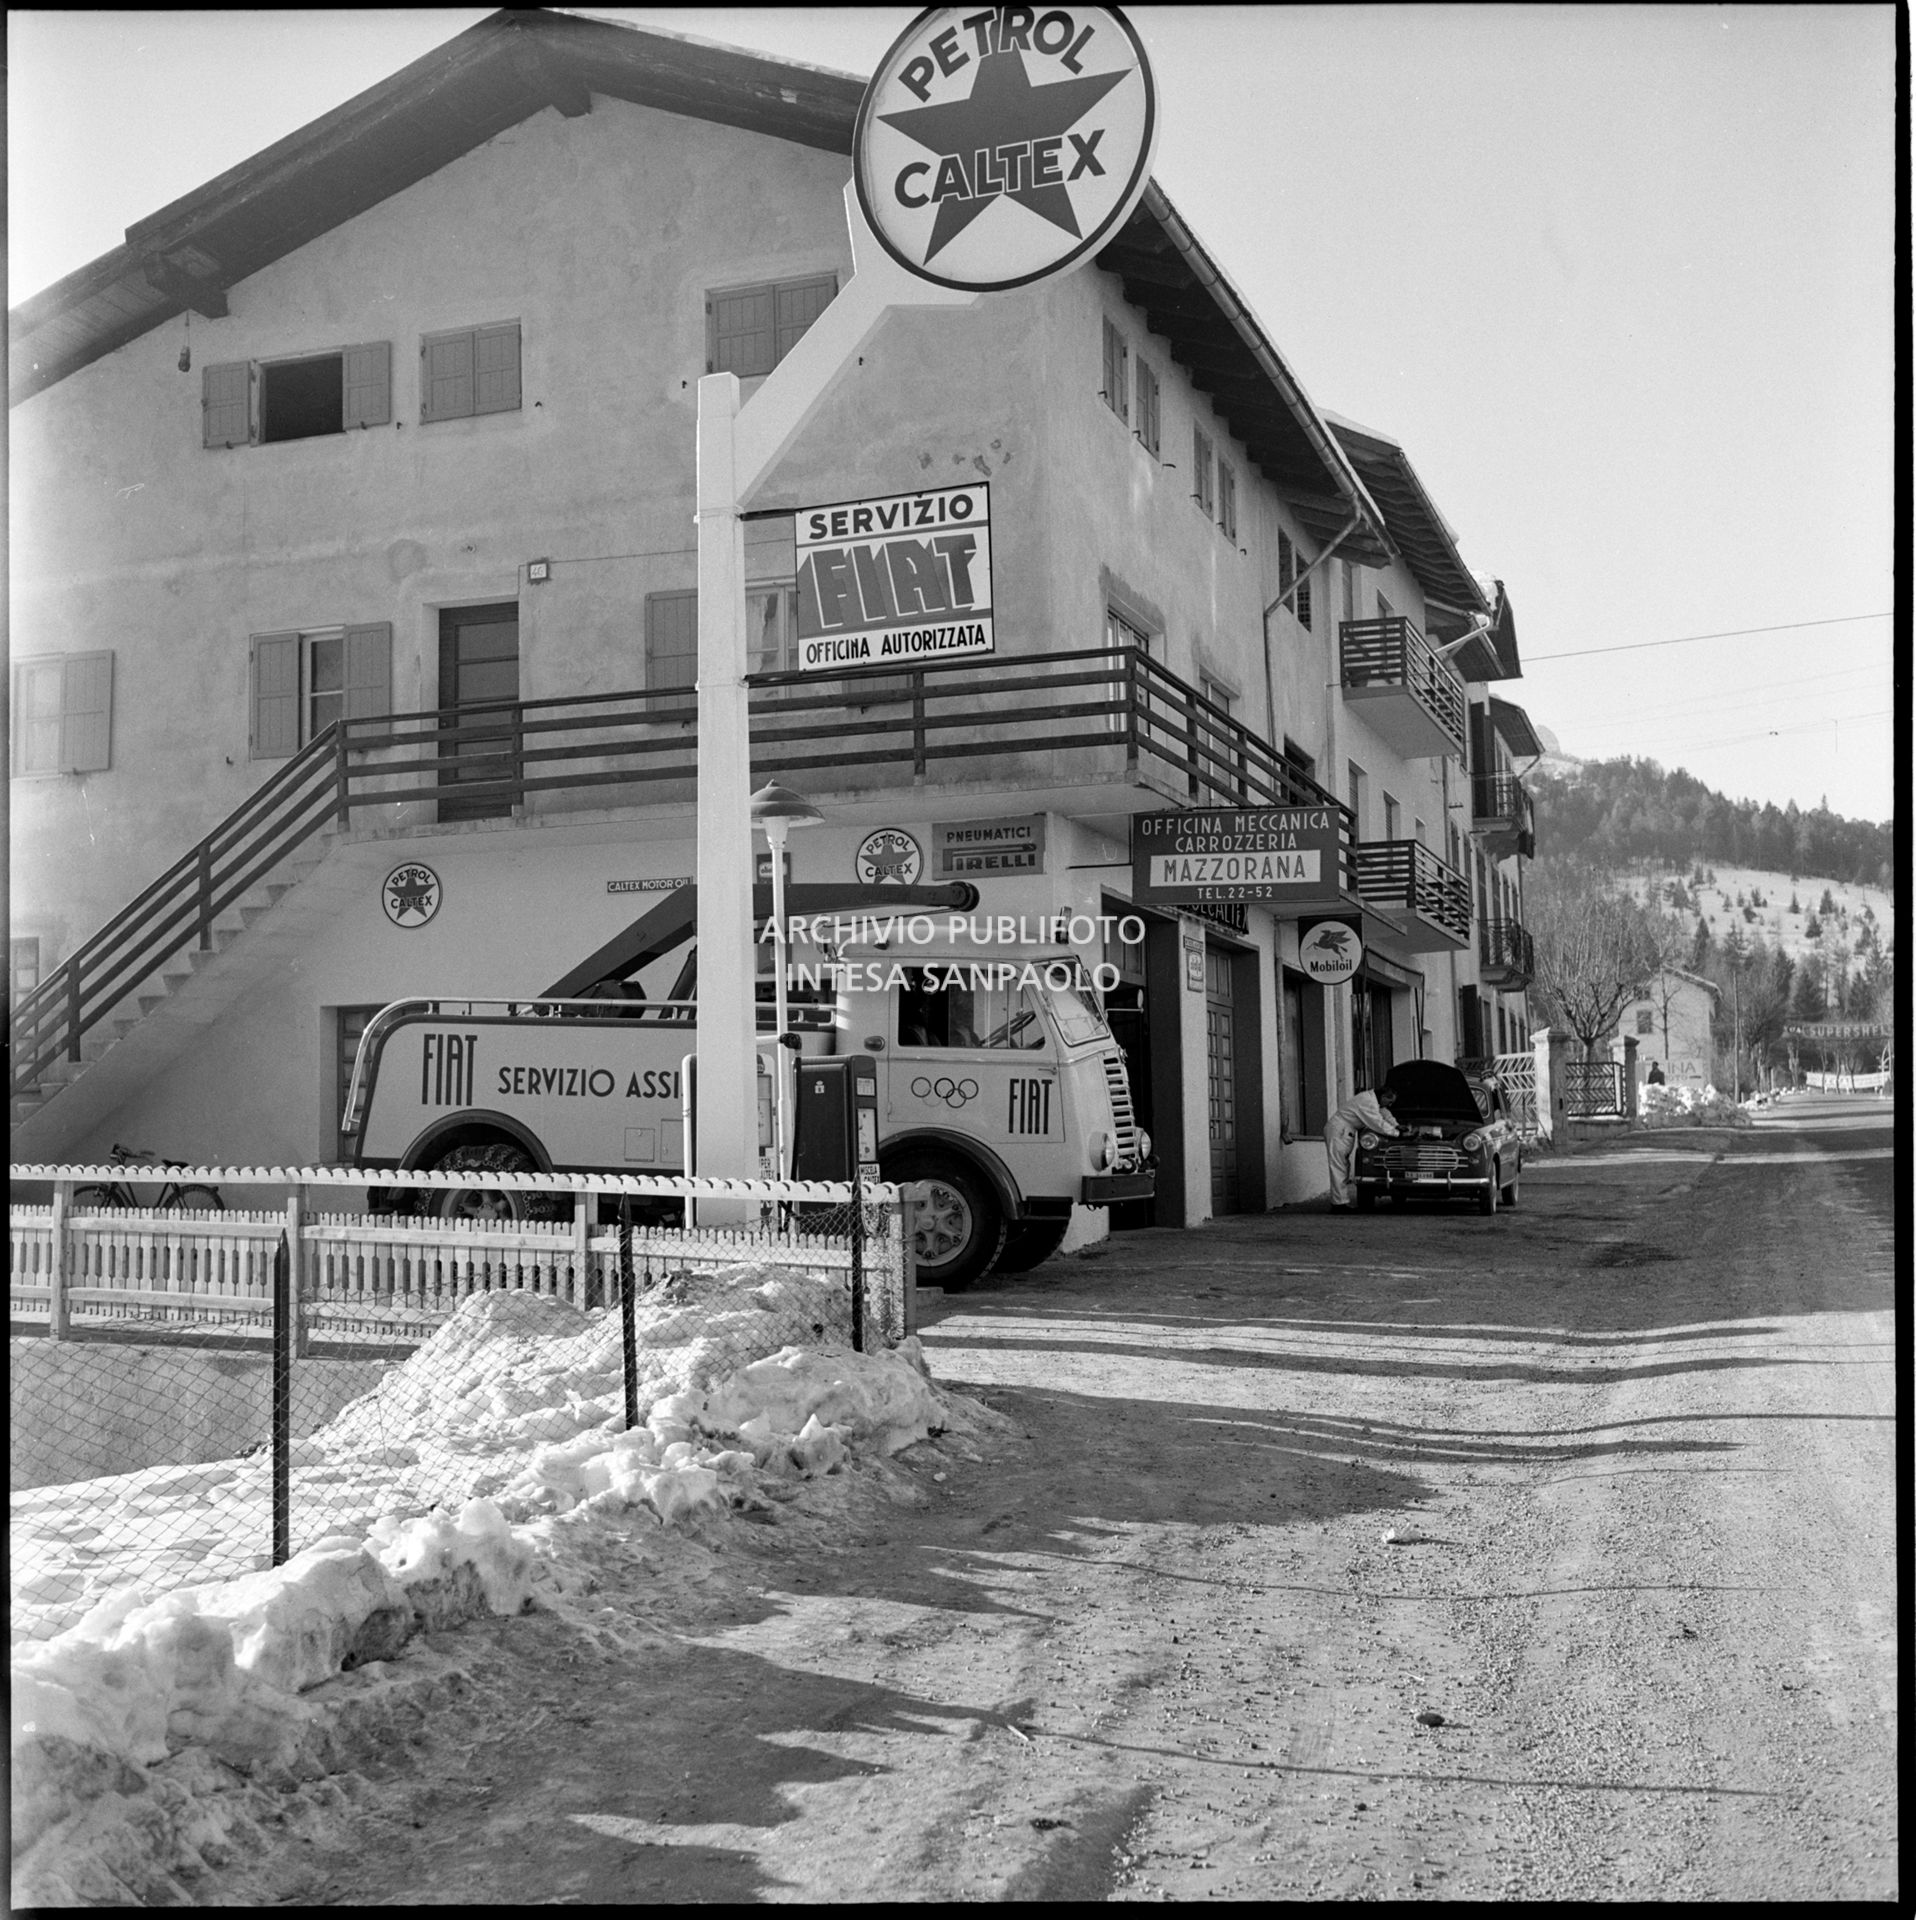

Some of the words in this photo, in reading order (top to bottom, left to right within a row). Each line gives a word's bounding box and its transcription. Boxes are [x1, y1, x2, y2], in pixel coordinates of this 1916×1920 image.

[898, 6, 1096, 103] PETROL
[894, 128, 1107, 209] CALTEX
[809, 494, 973, 540] SERVIZIO
[798, 533, 977, 629] FIAT
[806, 637, 871, 664] OFFICINA
[881, 623, 986, 656] AUTORIZZATA
[946, 826, 1032, 843] PNEUMATICI
[1142, 817, 1222, 836] OFFICINA
[1235, 811, 1330, 833] MECCANICA
[866, 833, 911, 855] PETROL
[1175, 832, 1297, 853] CARROZZERIA
[865, 862, 913, 878] CALTEX
[942, 843, 1037, 872] PIRELLI
[1163, 855, 1306, 882] MAZZORANA
[391, 868, 431, 887] PETROL
[608, 882, 640, 892] CALTEX
[642, 879, 674, 890] MOTOR
[390, 895, 433, 909] CALTEX
[1310, 959, 1353, 973] Mobiloil
[421, 1033, 478, 1106] FIAT
[497, 1066, 615, 1097] SERVIZIO
[625, 1070, 683, 1099] ASSI
[1008, 1078, 1053, 1135] FIAT
